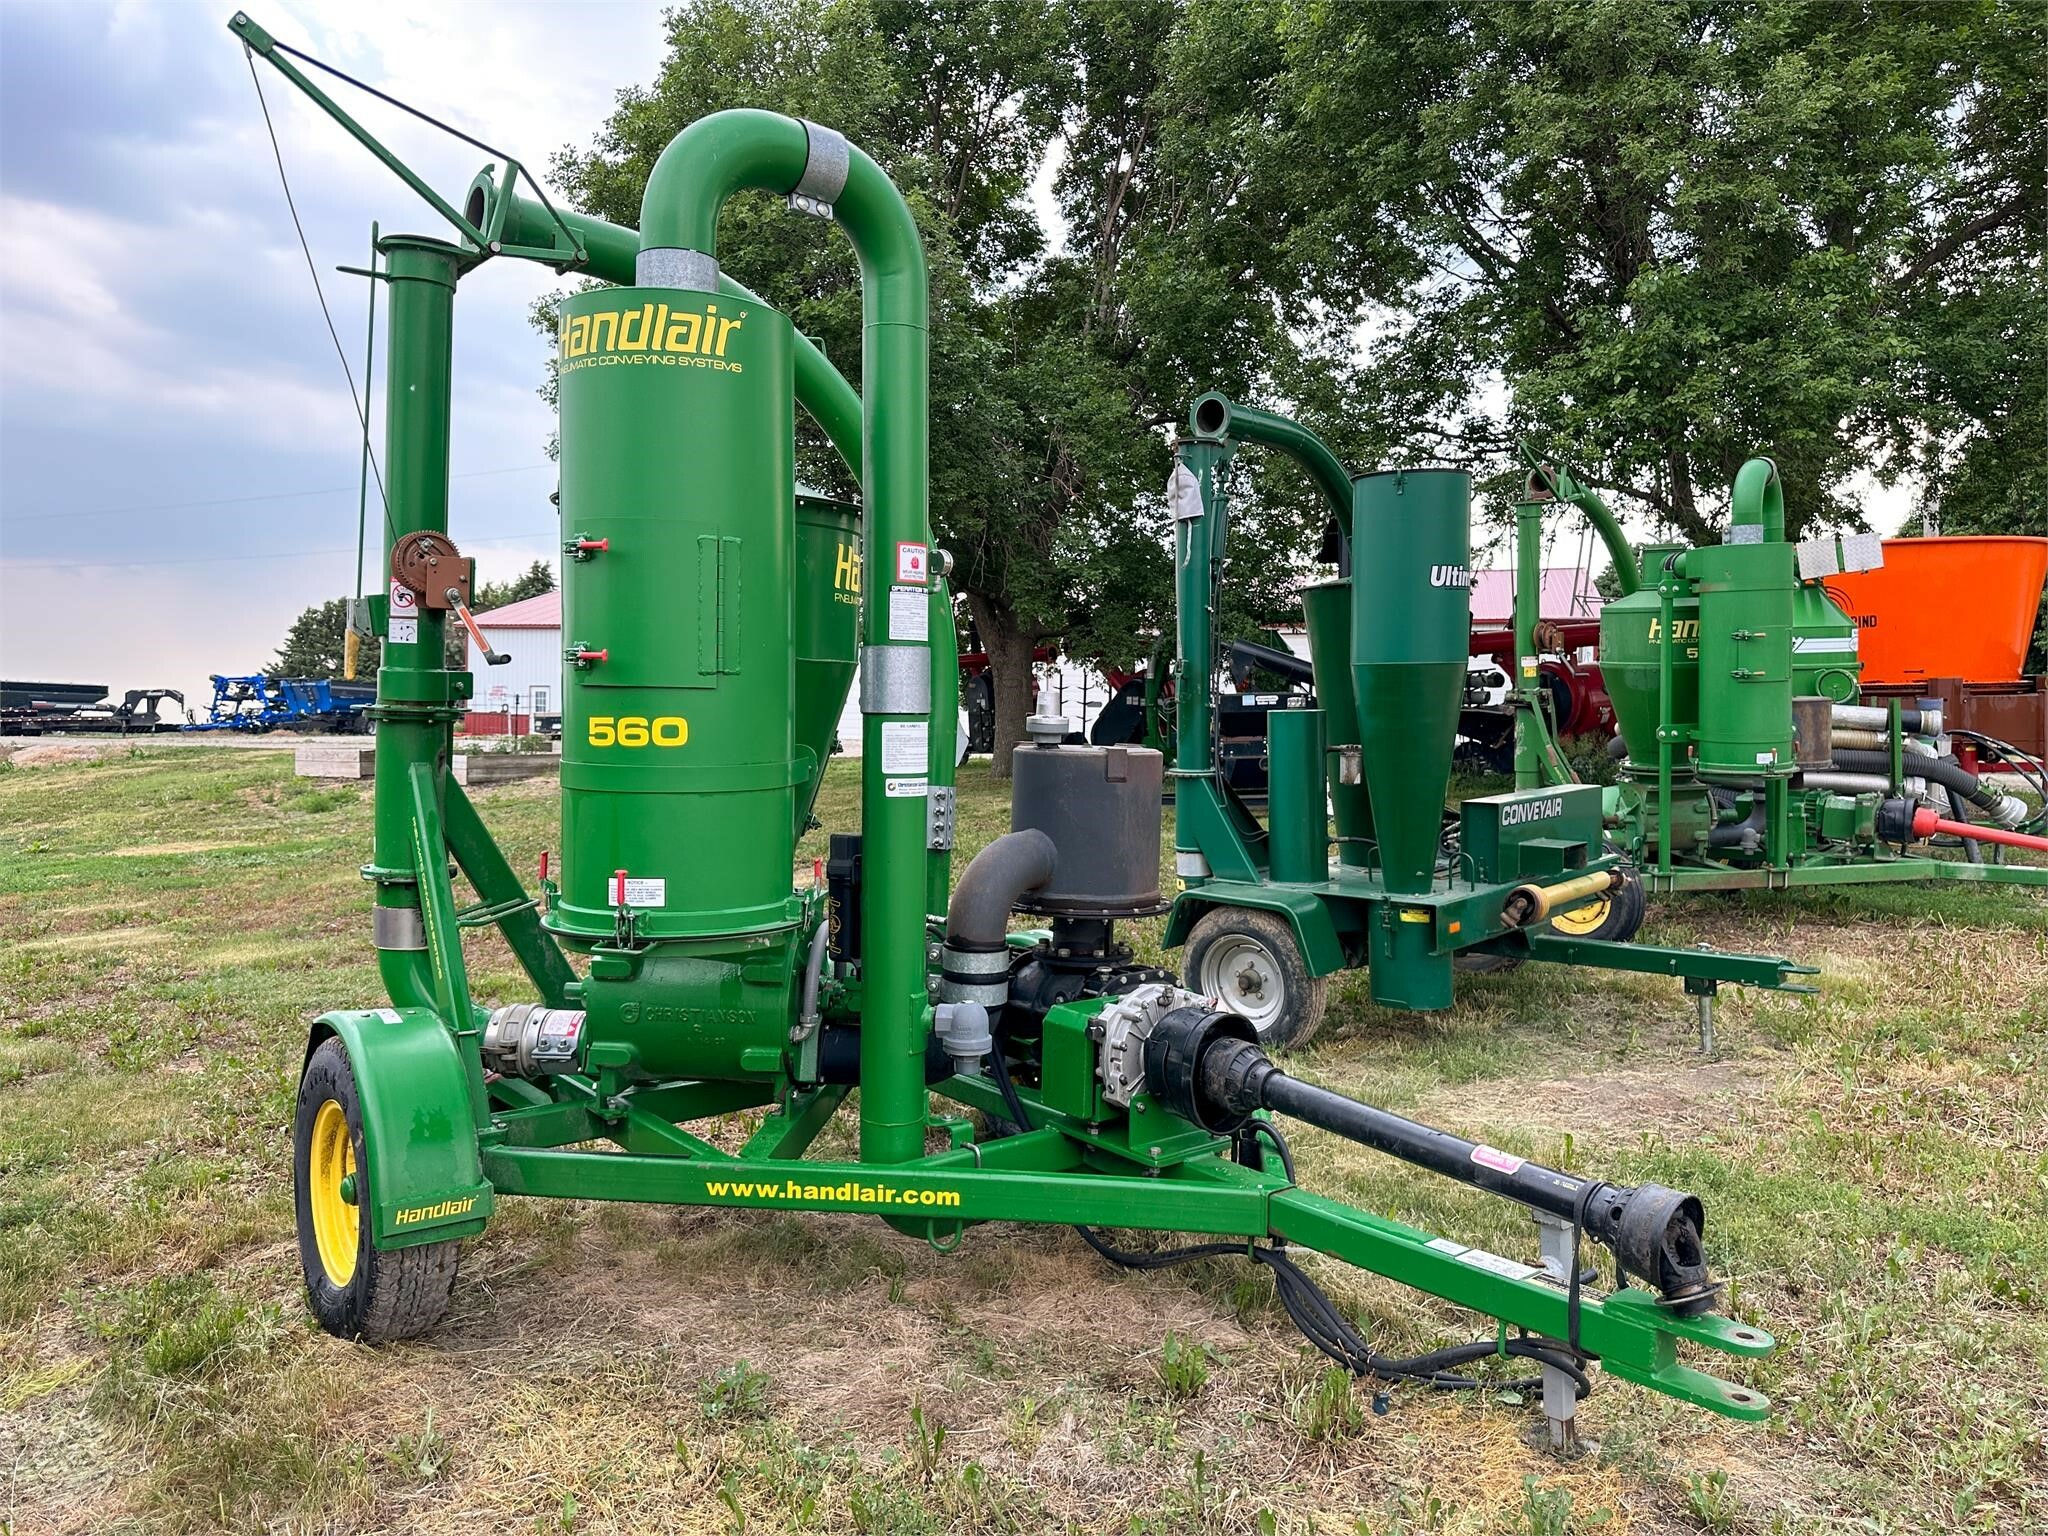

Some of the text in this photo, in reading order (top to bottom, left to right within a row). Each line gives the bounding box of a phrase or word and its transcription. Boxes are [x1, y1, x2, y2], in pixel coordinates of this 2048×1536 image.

[558, 303, 742, 361] Handlair
[598, 354, 676, 366] CONVEYING
[678, 356, 743, 373] SYSTEMS
[588, 716, 688, 747] 560
[1502, 797, 1563, 827] CONVEYAIR
[706, 1181, 960, 1206] www.handlair.com
[395, 1196, 478, 1226] Handlair
